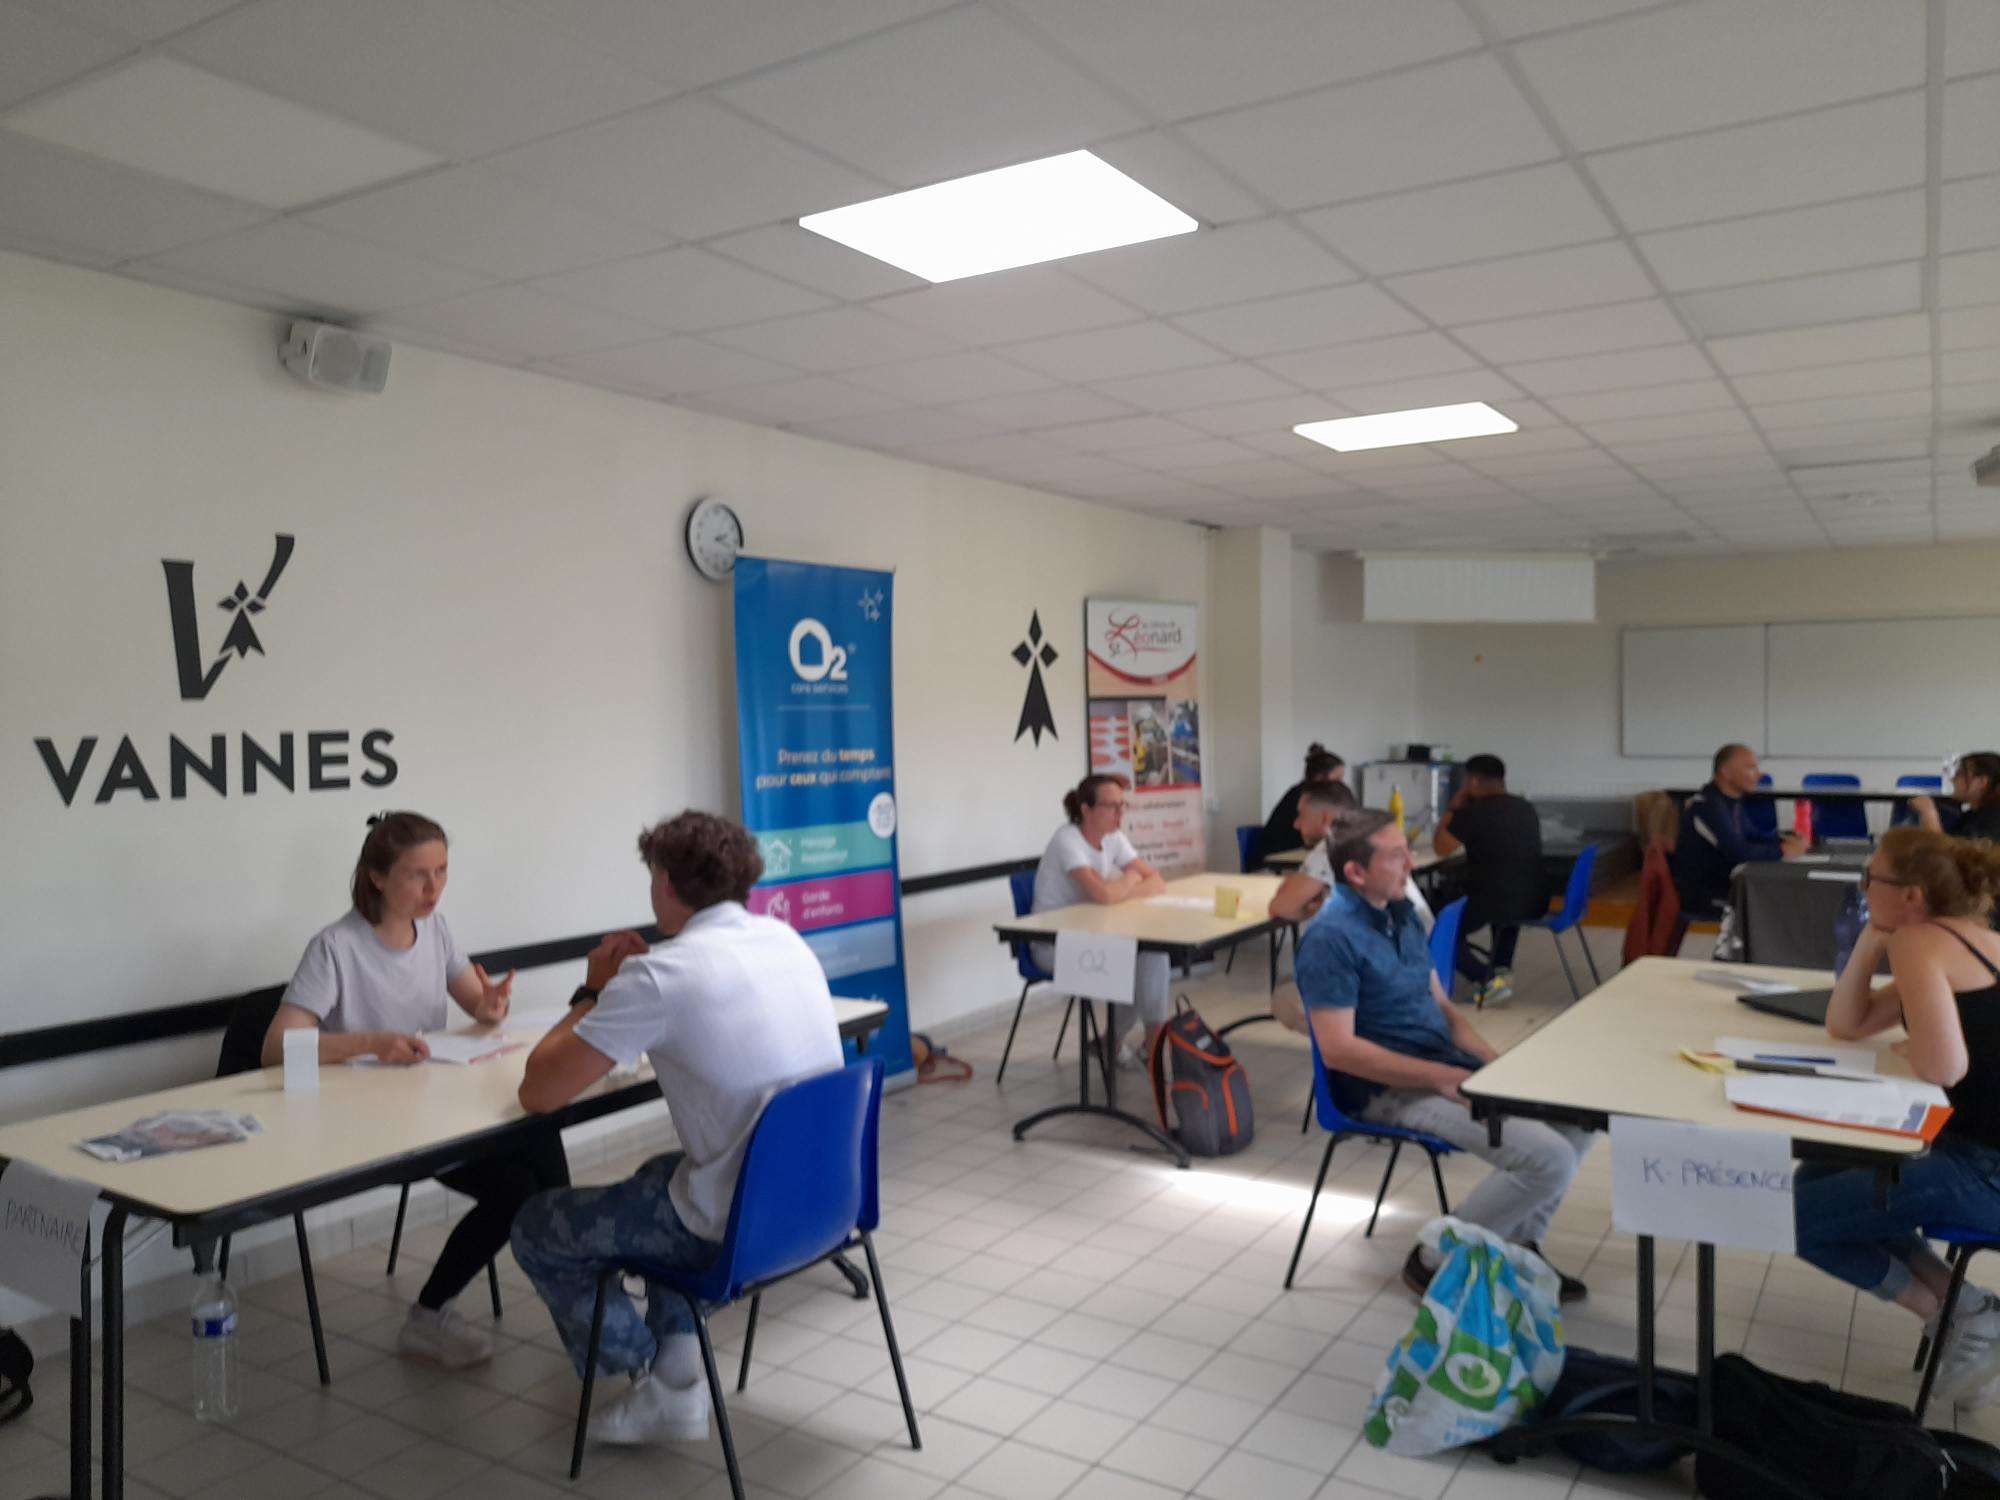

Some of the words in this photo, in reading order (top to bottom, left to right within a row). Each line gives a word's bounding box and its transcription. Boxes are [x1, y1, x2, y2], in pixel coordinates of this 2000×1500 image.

[838, 748, 875, 765] temps
[33, 728, 399, 808] VANNES
[756, 773, 788, 790] pour
